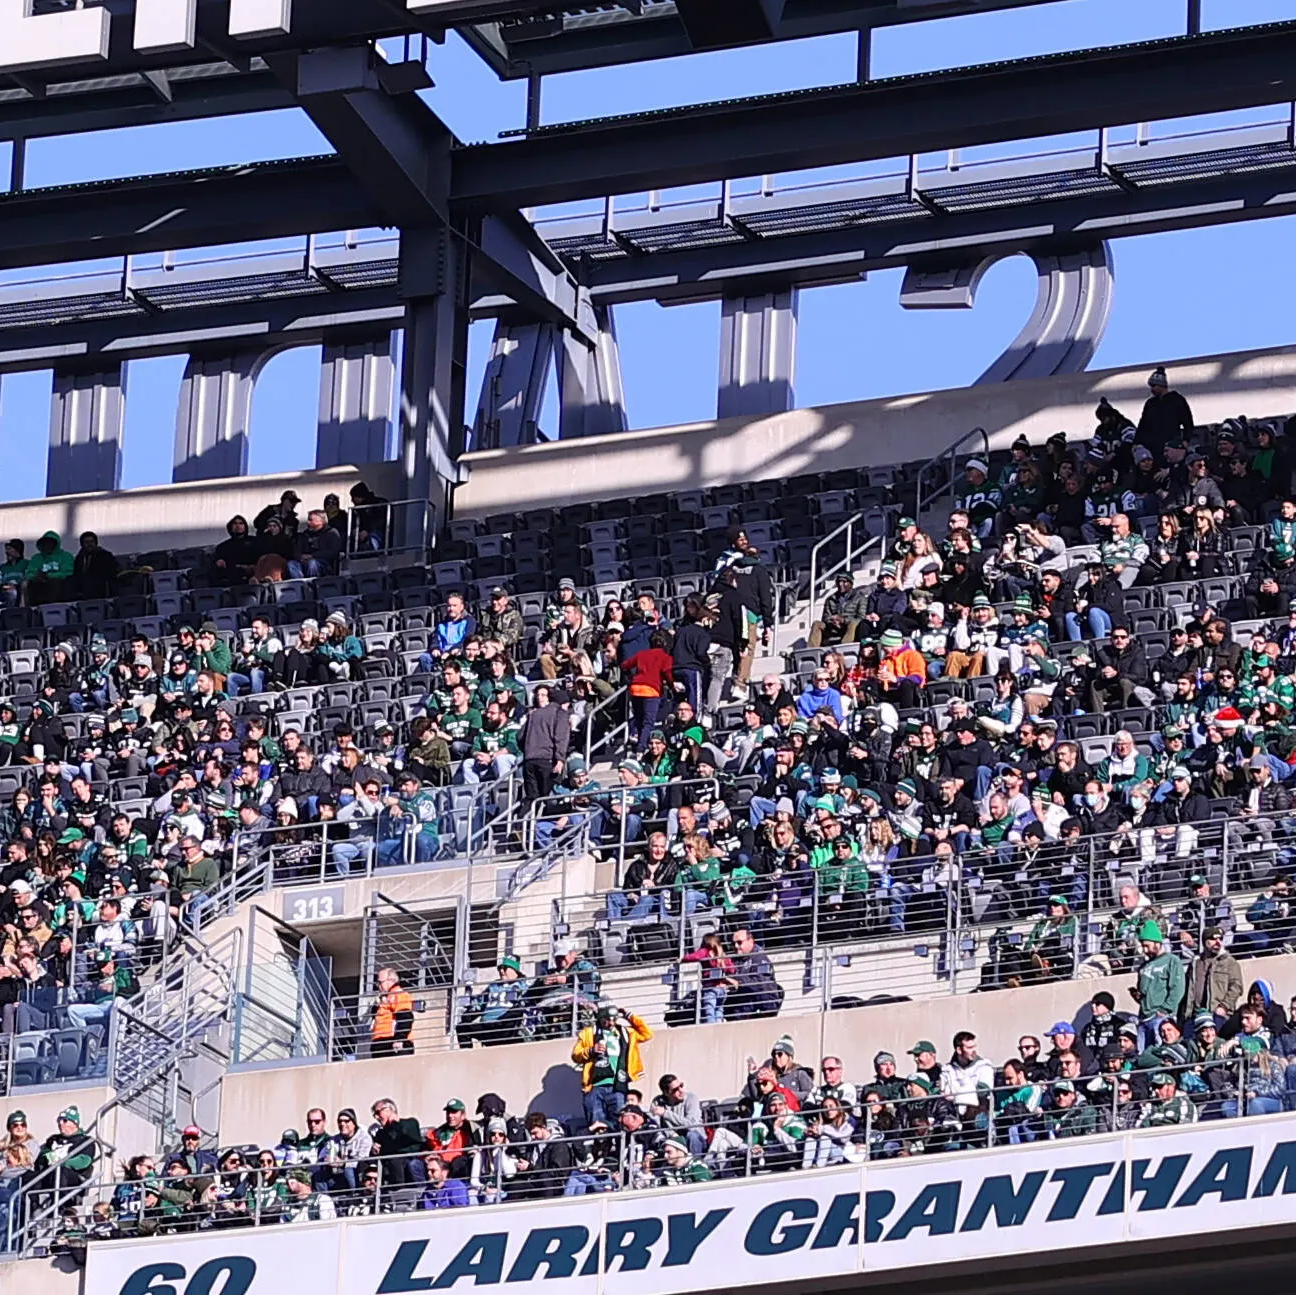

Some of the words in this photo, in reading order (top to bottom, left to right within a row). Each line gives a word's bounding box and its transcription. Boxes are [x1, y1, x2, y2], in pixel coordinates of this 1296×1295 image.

[293, 895, 334, 921] 313
[119, 1255, 257, 1295] 60
[376, 1208, 733, 1294] LARRY
